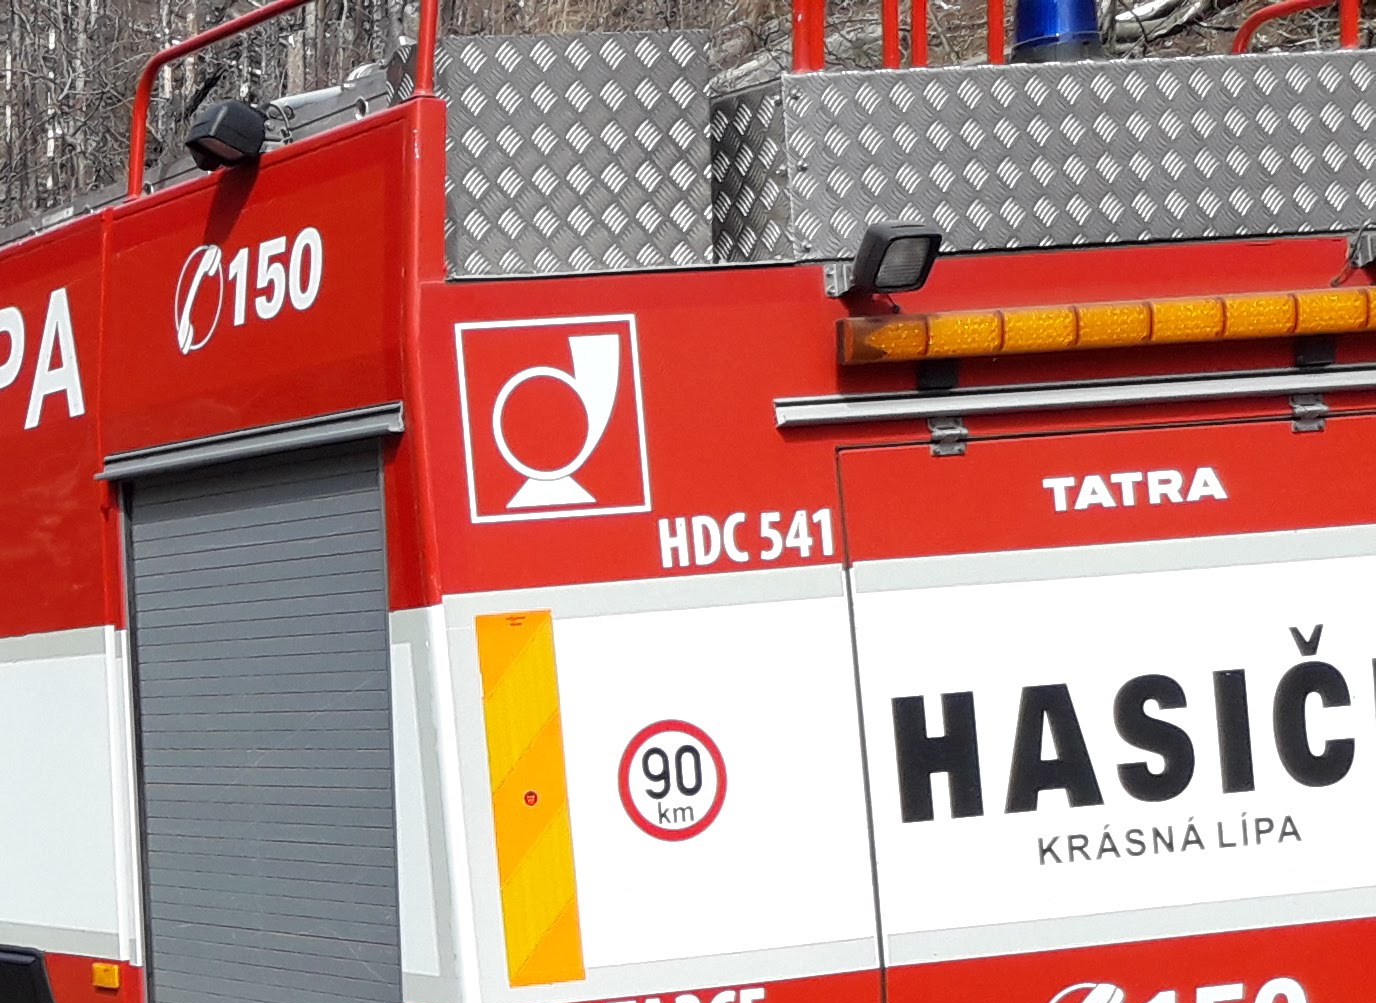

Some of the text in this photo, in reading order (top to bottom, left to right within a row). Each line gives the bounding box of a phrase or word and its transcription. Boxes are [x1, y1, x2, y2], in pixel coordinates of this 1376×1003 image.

[229, 227, 323, 326] 150
[1042, 466, 1228, 512] TATRA
[658, 508, 834, 569] HDC 541
[891, 624, 1376, 824] HASIČ
[642, 744, 703, 800] 90
[657, 801, 695, 824] km
[1037, 811, 1302, 866] KRÁSNÁ LÍPA
